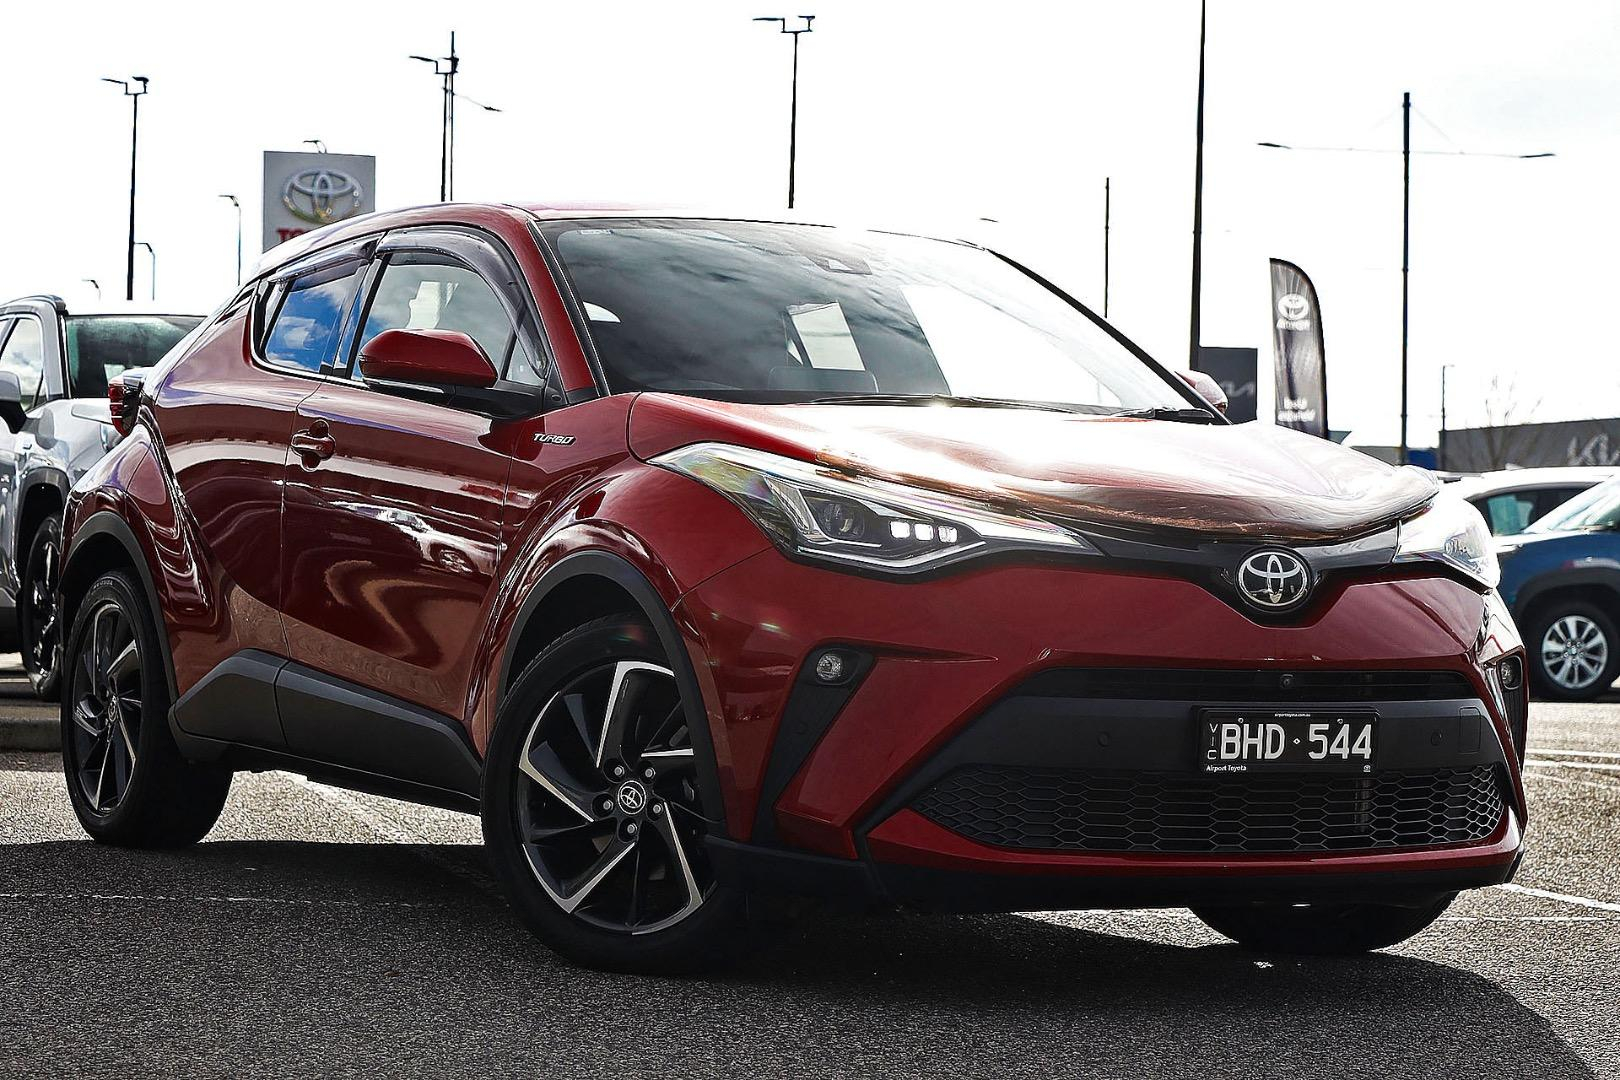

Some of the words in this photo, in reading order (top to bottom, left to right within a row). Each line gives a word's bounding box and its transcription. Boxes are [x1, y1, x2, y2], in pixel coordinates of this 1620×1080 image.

[534, 433, 574, 444] TURBO
[1220, 723, 1286, 760] BHD
[1308, 723, 1373, 760] 544
[1206, 764, 1227, 773] Airport
[1228, 764, 1248, 773] Toyota
